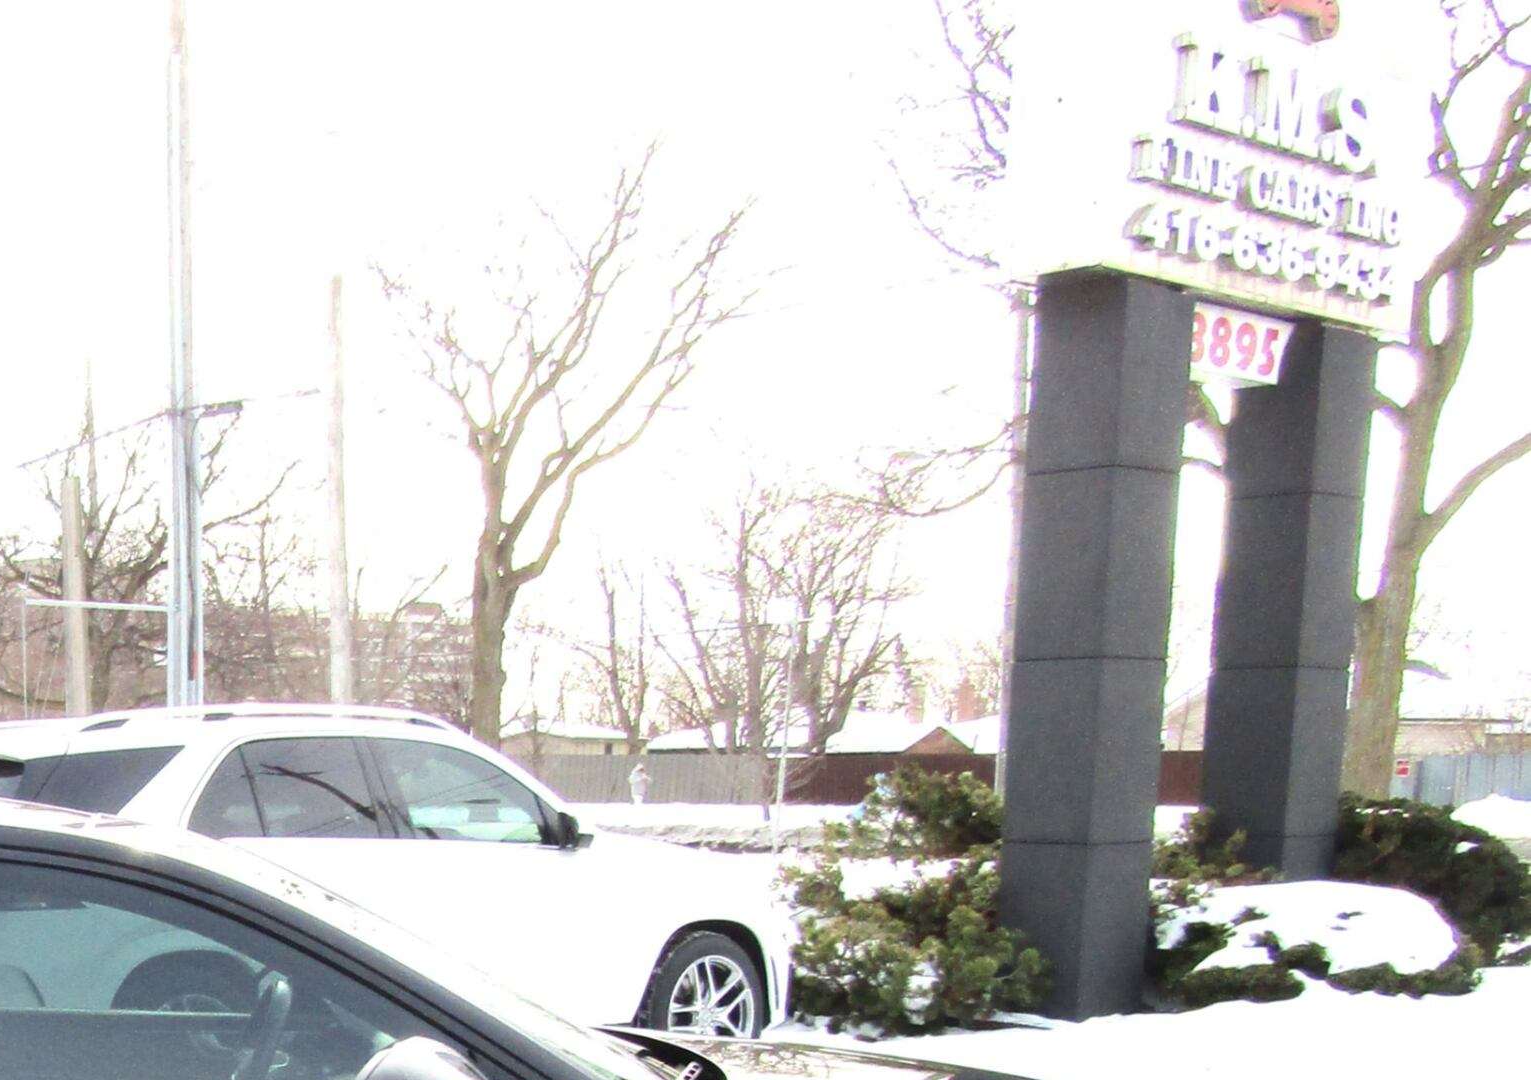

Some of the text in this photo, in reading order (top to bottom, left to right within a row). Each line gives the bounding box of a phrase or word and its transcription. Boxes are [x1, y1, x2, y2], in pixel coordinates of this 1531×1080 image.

[1127, 133, 1238, 202] FINE
[1240, 164, 1337, 229] CARS
[1123, 202, 1393, 302] 416-636-9434
[1190, 311, 1279, 376] 3895
